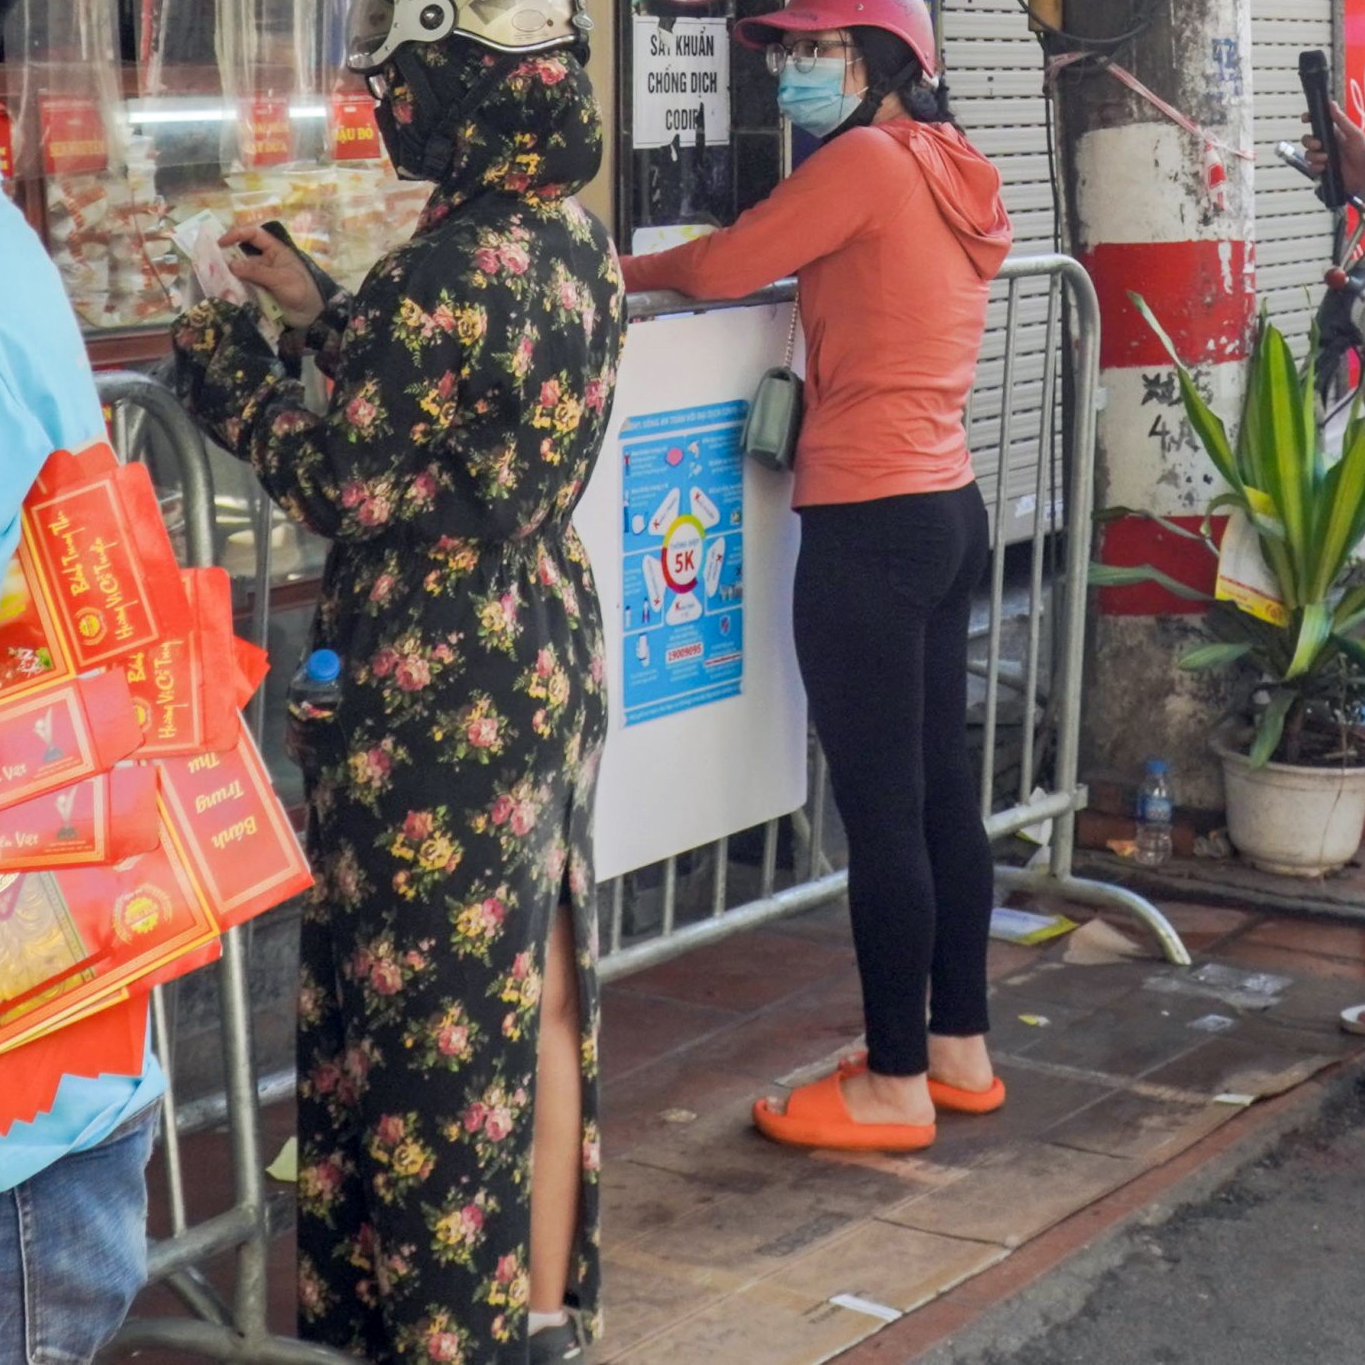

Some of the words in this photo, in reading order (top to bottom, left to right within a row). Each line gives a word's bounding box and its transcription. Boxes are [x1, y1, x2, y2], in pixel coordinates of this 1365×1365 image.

[675, 26, 715, 57] KHUẨN
[647, 63, 687, 94] CHỐNG
[690, 71, 718, 99] DỊCH
[674, 548, 696, 575] 5K
[187, 751, 221, 774] Thu
[195, 779, 245, 814] Trung
[211, 815, 258, 849] Bánh
